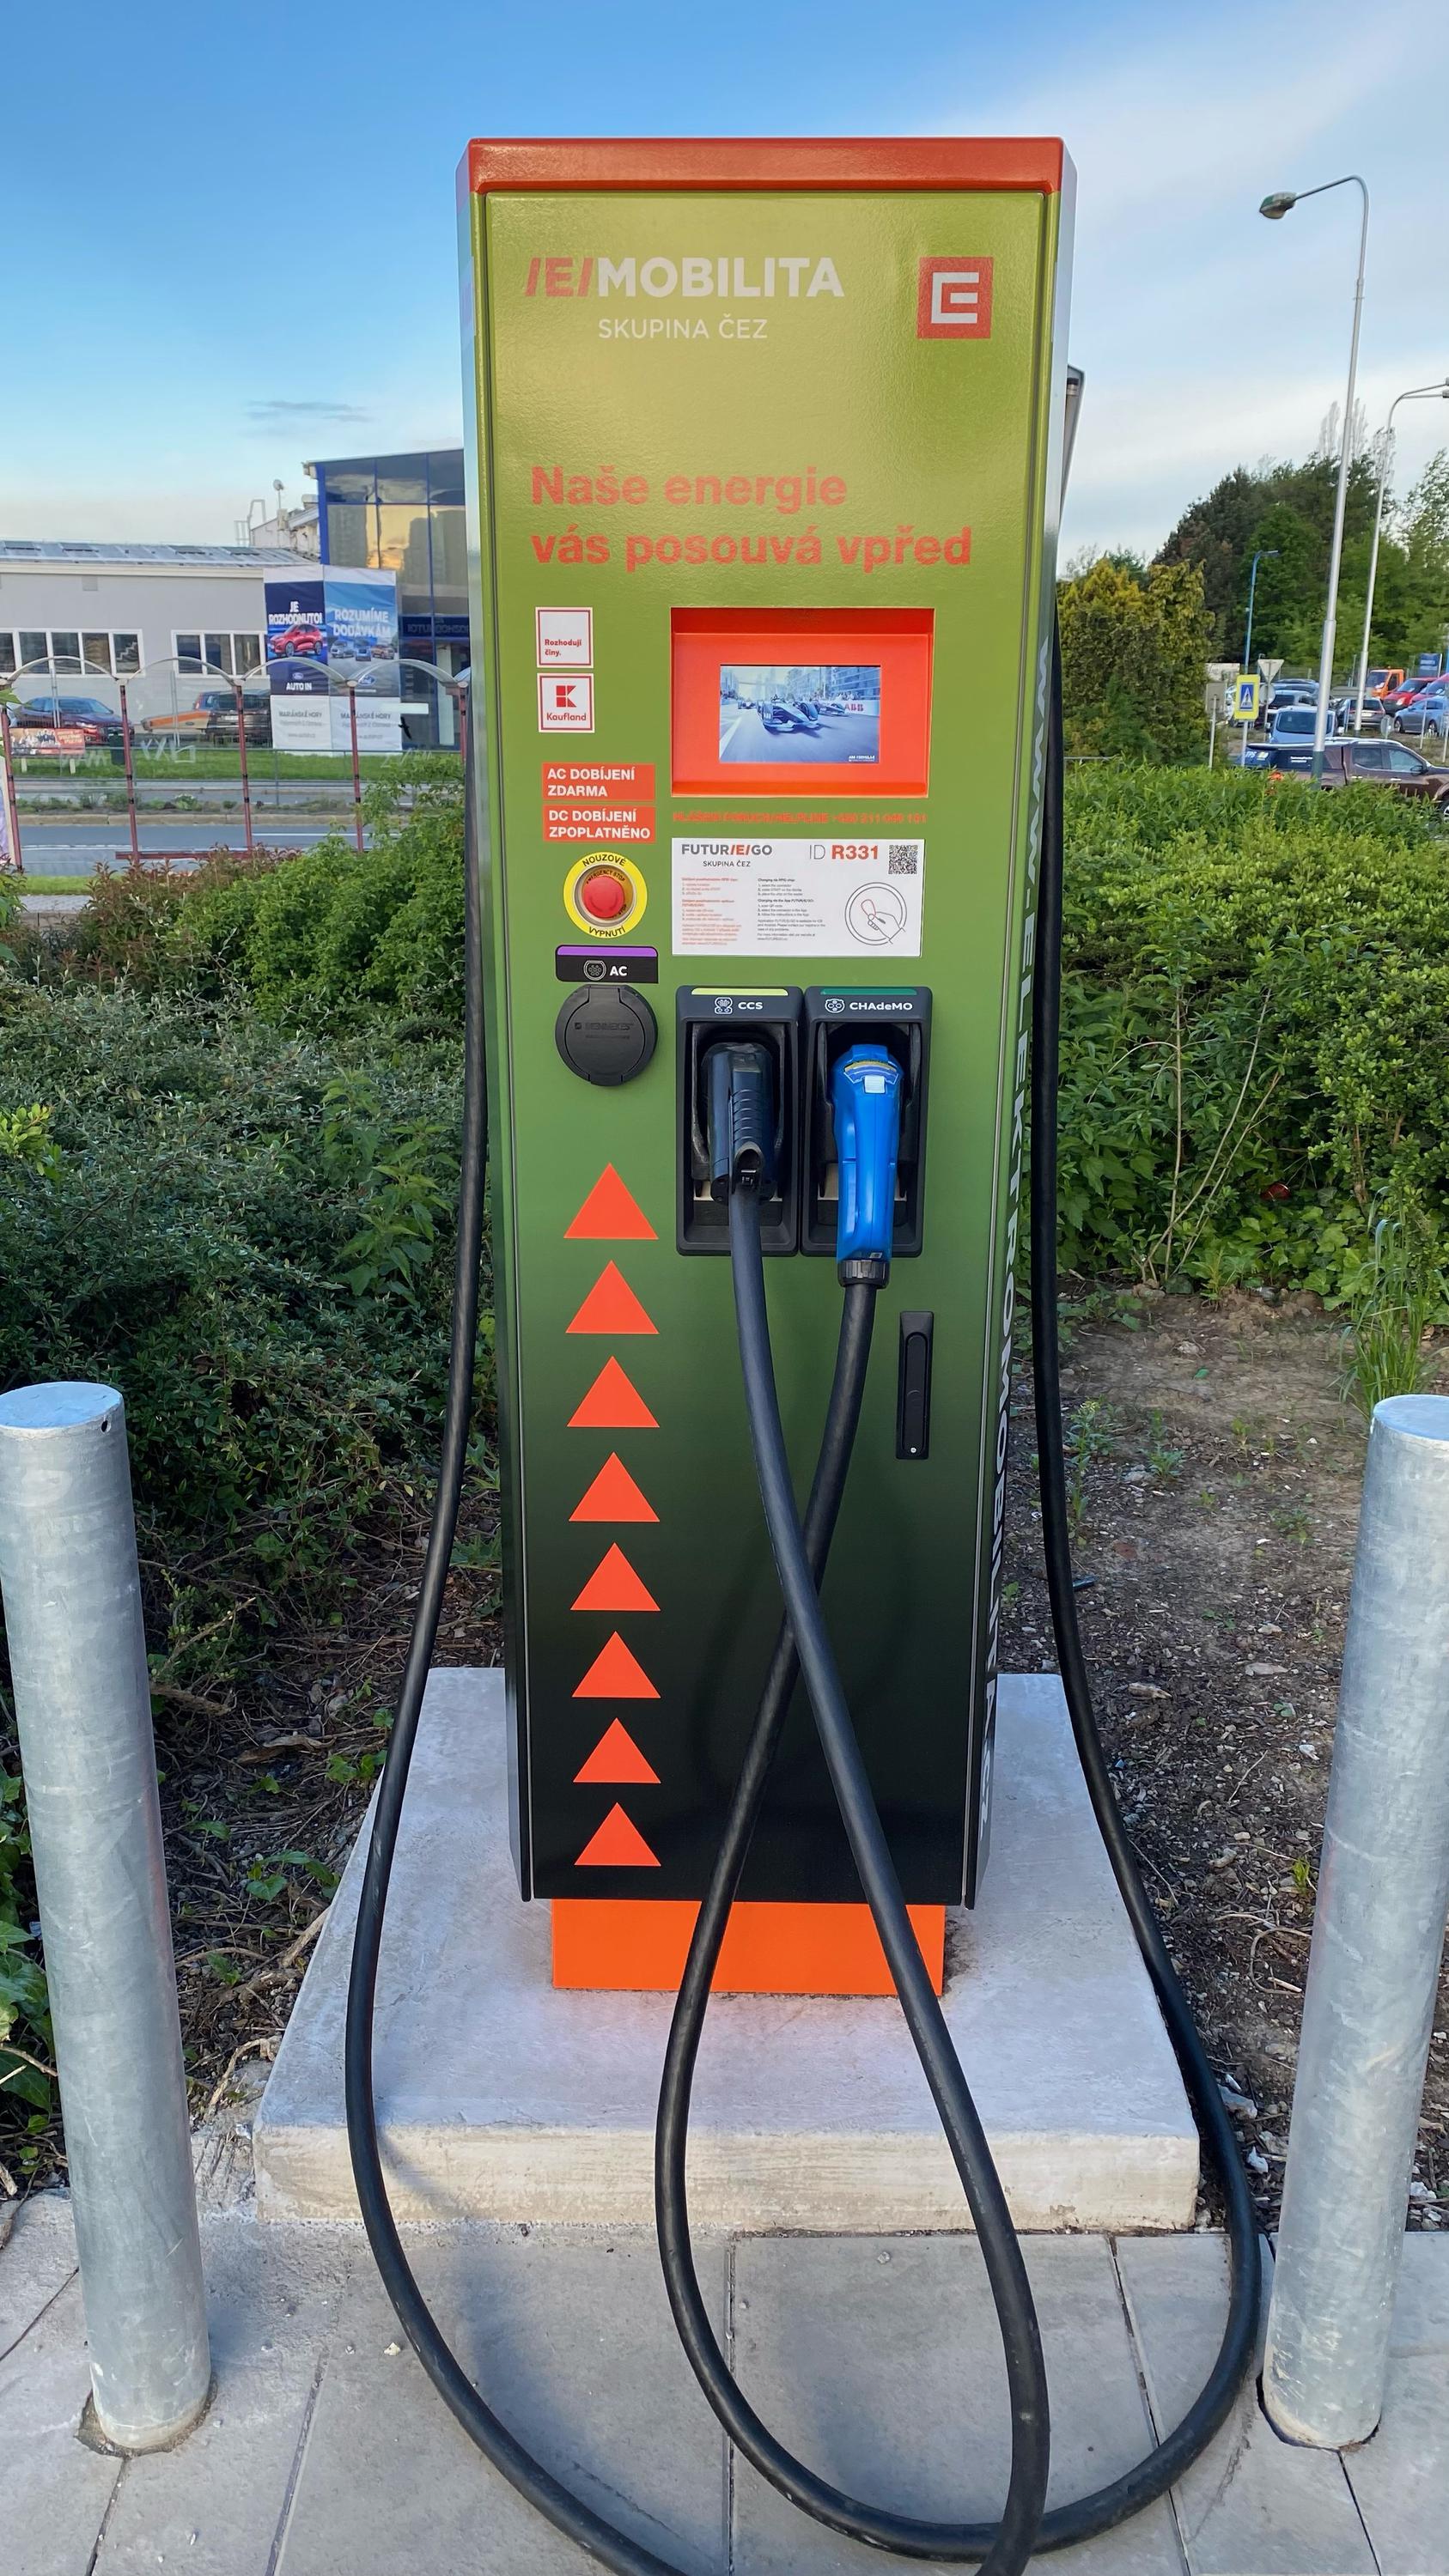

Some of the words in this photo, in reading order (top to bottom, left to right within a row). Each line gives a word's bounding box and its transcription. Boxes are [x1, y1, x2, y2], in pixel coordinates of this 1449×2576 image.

[598, 319, 709, 339] SKUPINA
[718, 313, 768, 339] ČEZ
[531, 465, 649, 506] Naše
[664, 465, 848, 514] energie
[531, 525, 611, 565] vás
[625, 525, 823, 572] posouvá
[838, 525, 973, 574] vpřed
[289, 601, 299, 612] JE
[334, 607, 389, 623] ROZUMÍME
[545, 639, 581, 647] Rozhodují
[545, 648, 562, 657] činy.
[286, 683, 303, 691] AUTO
[844, 703, 864, 712] ABB
[546, 712, 587, 721] Kaufland
[547, 768, 567, 781] AC
[569, 766, 636, 781] DOBÍJENÍ
[547, 785, 608, 798] ZDARMA
[549, 810, 568, 822] DC
[570, 807, 636, 823] DOBÍJENÍ
[549, 824, 651, 840] ZPOPLATNĚNO
[809, 844, 826, 860] ID
[831, 845, 879, 860] R331
[582, 854, 627, 867] NOUZOVÉ
[736, 859, 752, 867] ČEZ
[588, 925, 626, 938] VYPNUTÍ
[609, 965, 628, 976] AC
[738, 1001, 764, 1011] CCS
[849, 1001, 914, 1012] CHAdeMO
